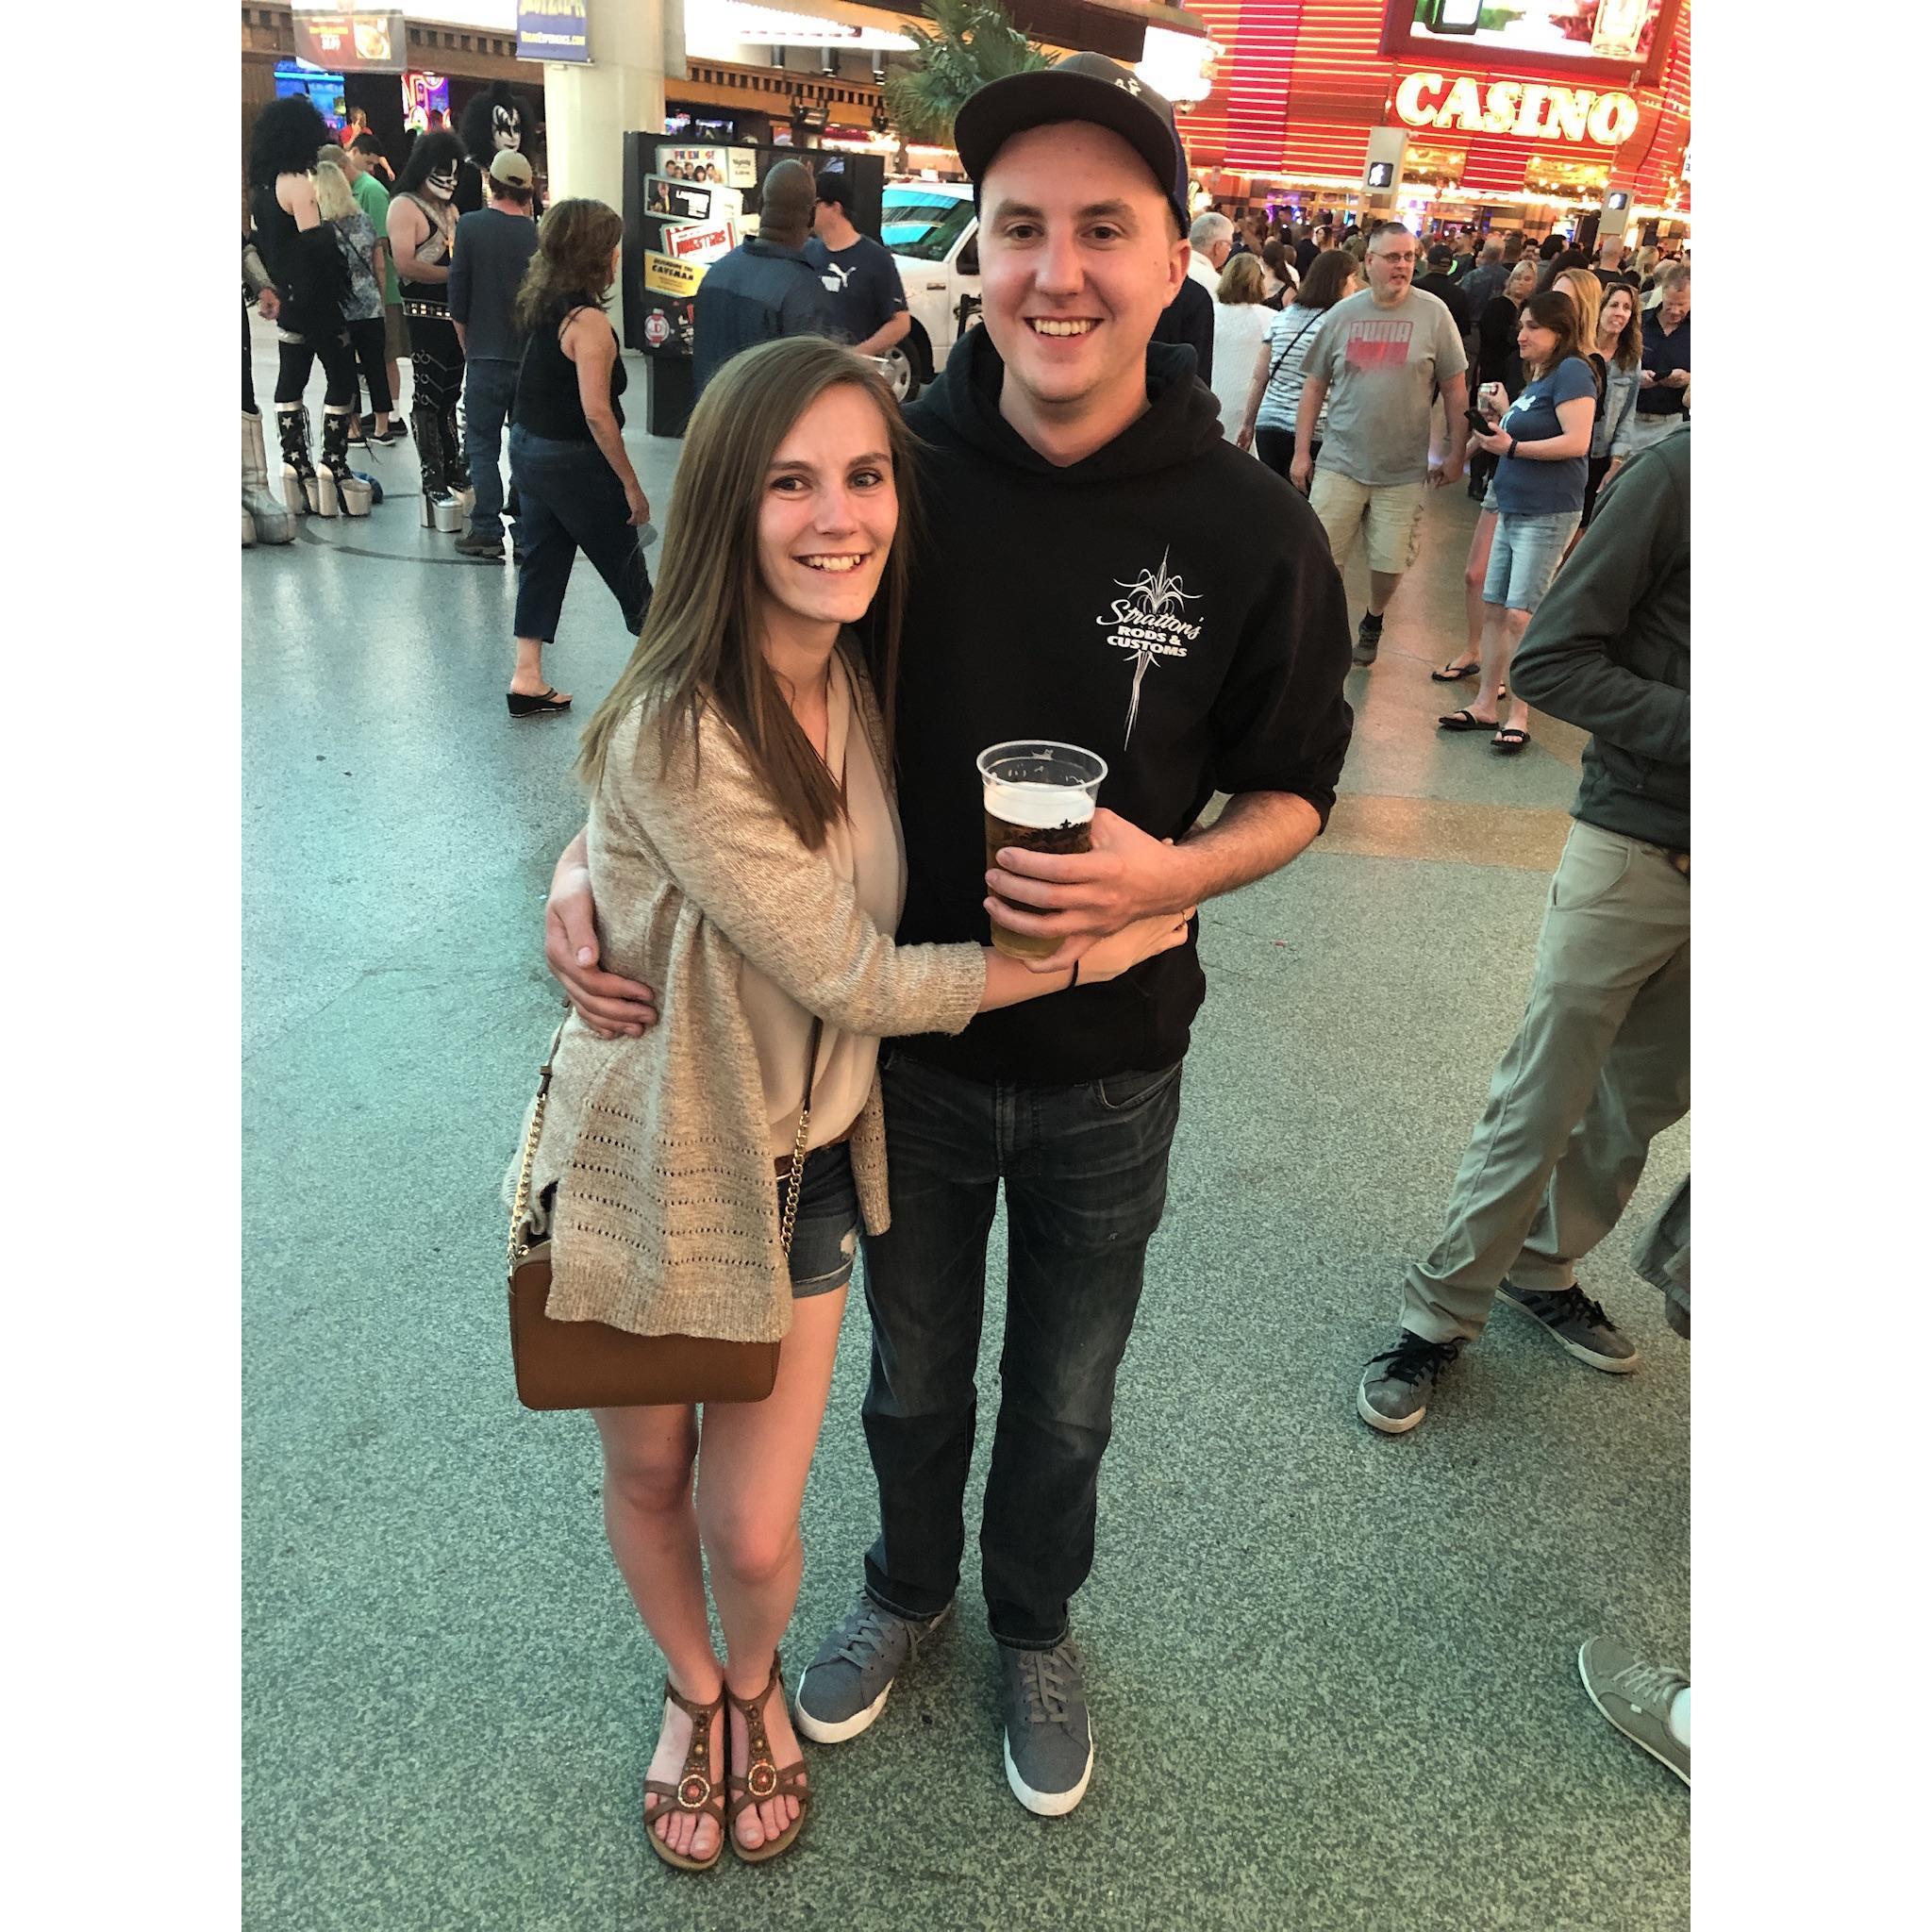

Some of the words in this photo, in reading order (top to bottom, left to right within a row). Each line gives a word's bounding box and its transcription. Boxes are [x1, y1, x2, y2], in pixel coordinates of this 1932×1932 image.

[1395, 72, 1640, 145] CASINO
[675, 149, 715, 160] FRENS!
[652, 264, 694, 280] CAVEMAN
[1348, 320, 1413, 343] PUMA
[1118, 625, 1167, 642] RODS
[1169, 635, 1182, 646] &
[1107, 636, 1188, 658] CUSTOMS
